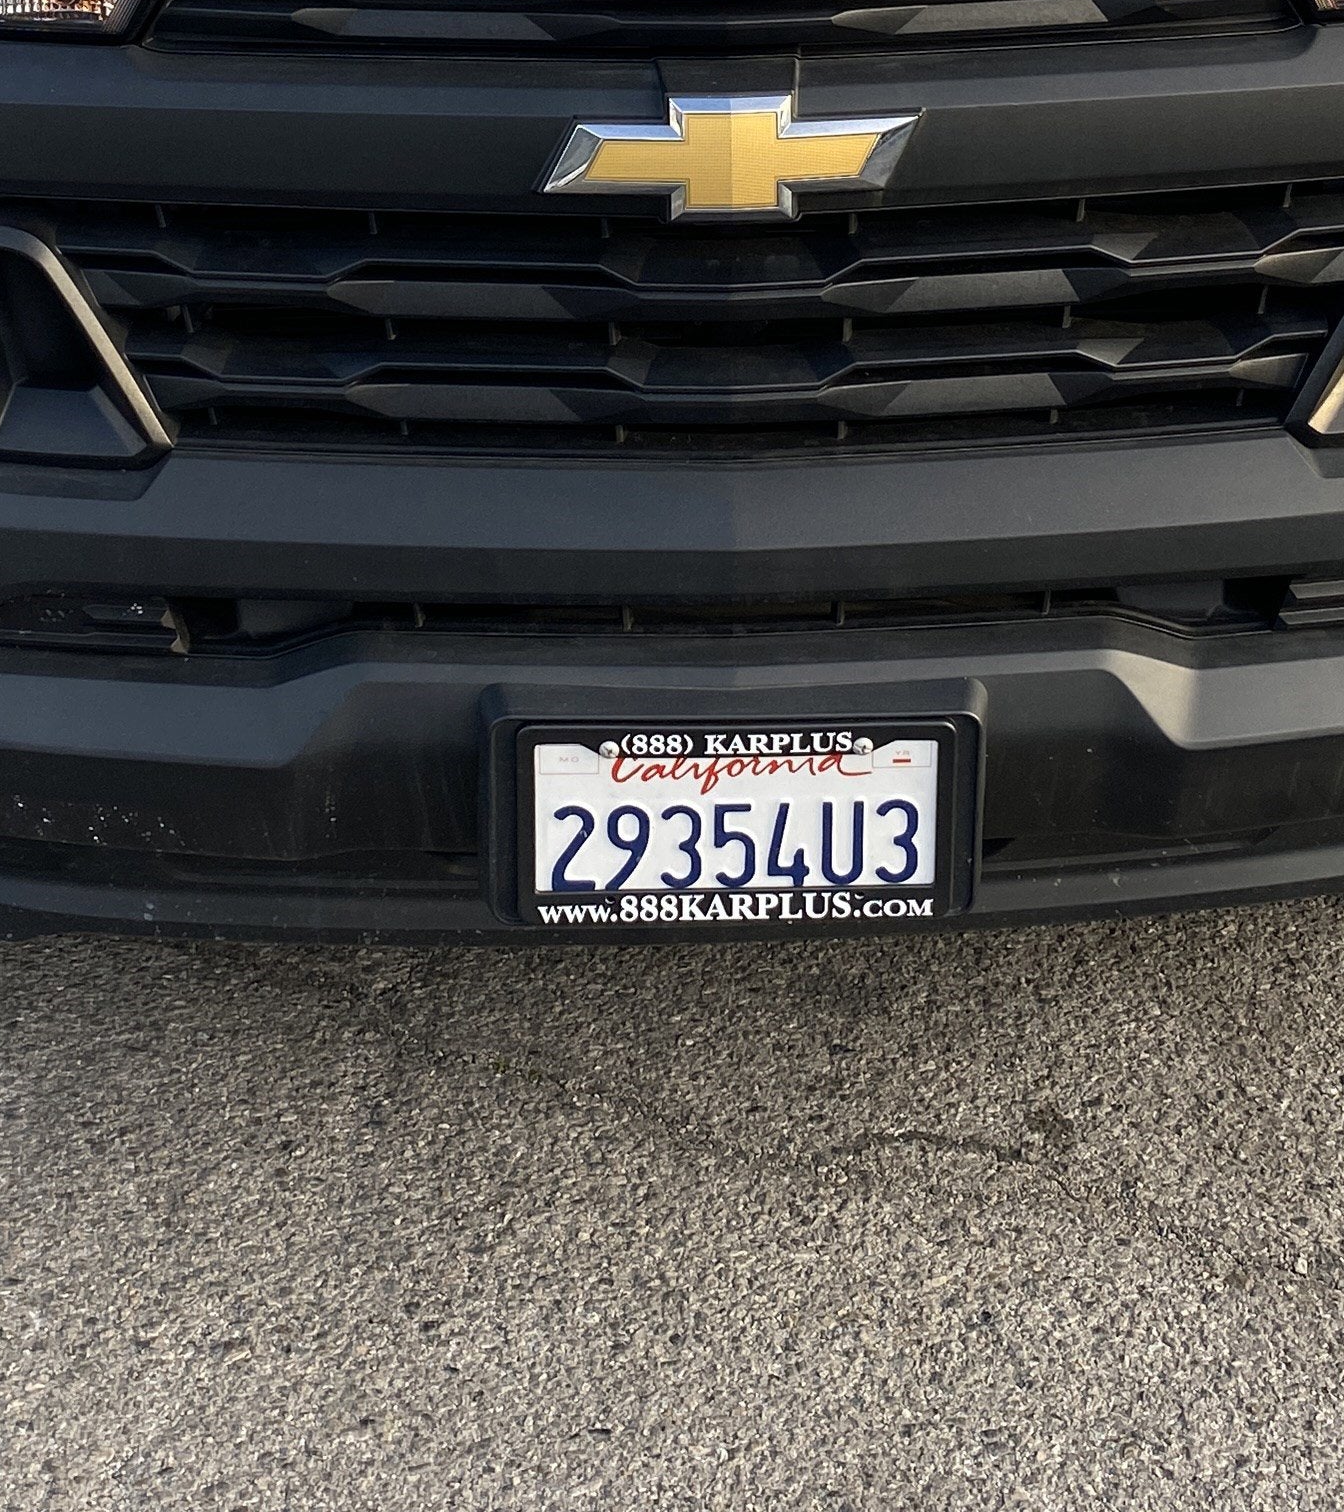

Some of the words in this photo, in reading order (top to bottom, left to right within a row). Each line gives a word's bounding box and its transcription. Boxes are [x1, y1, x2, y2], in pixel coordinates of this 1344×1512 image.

[620, 733, 694, 755] (888)
[703, 731, 853, 755] KARPLUS
[611, 755, 873, 795] California
[551, 798, 919, 891] 29354U3
